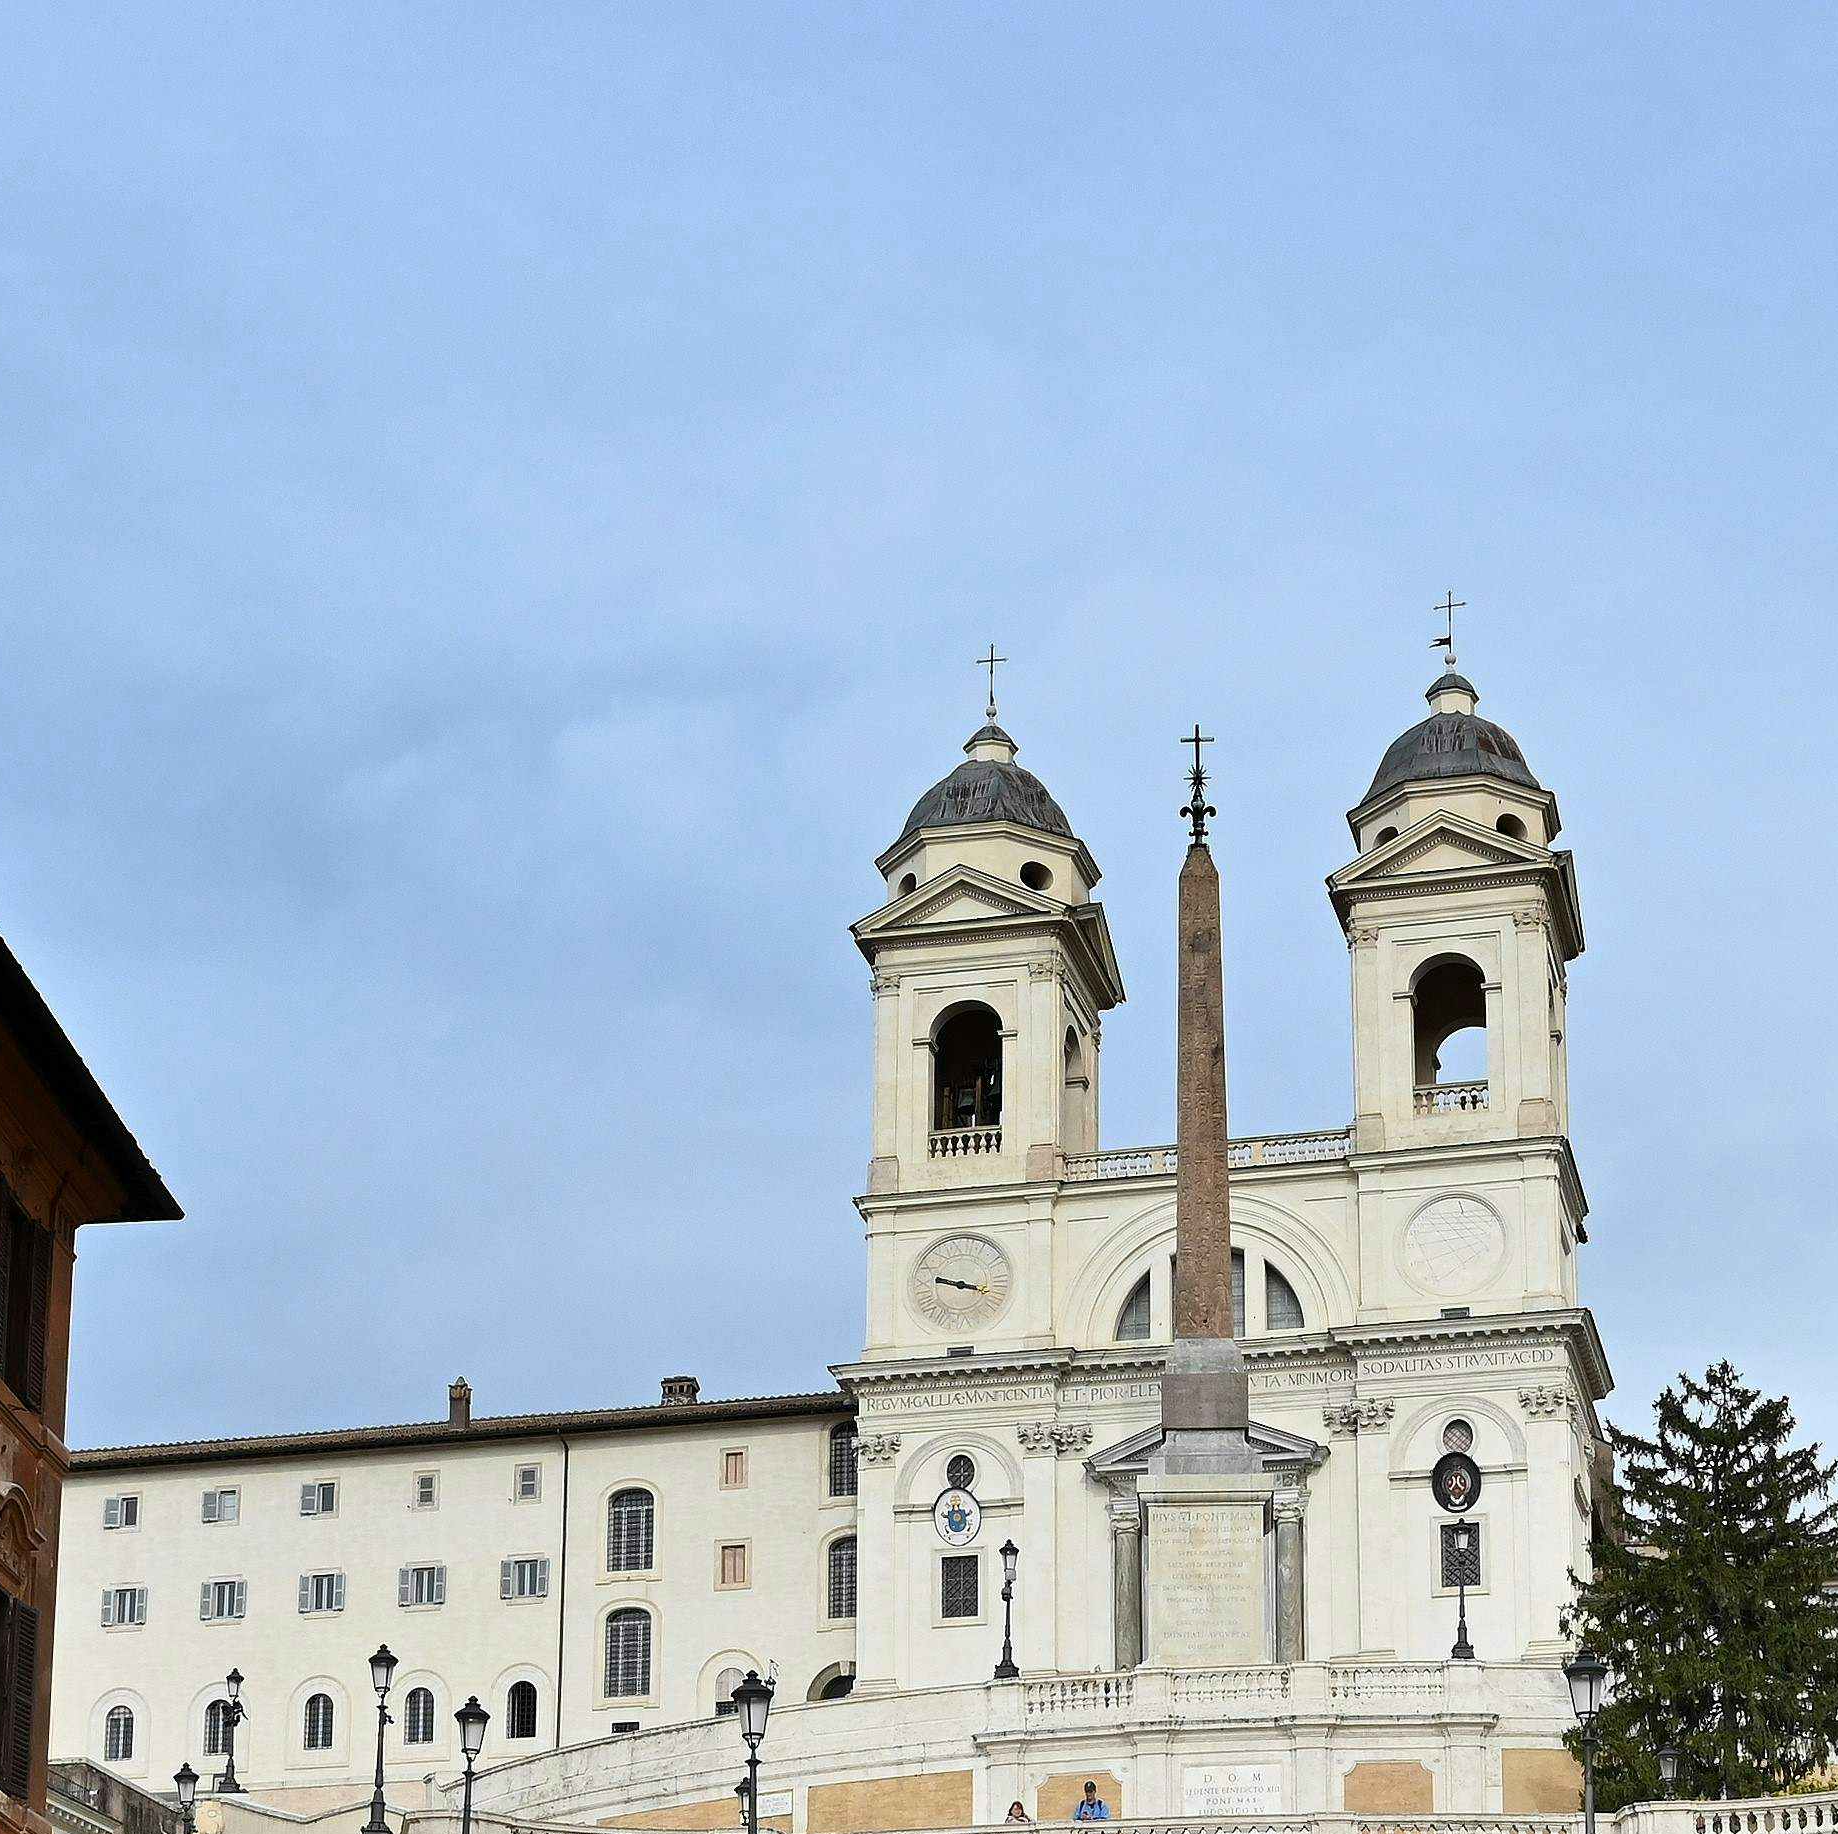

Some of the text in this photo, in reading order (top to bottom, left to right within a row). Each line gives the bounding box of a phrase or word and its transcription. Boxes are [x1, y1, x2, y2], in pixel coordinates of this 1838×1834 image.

[1362, 1357, 1443, 1375] SODALITAS
[1446, 1352, 1506, 1370] STRVXIT
[1062, 1387, 1083, 1402] ET
[1204, 1774, 1212, 1783] D
[1228, 1774, 1237, 1782] O
